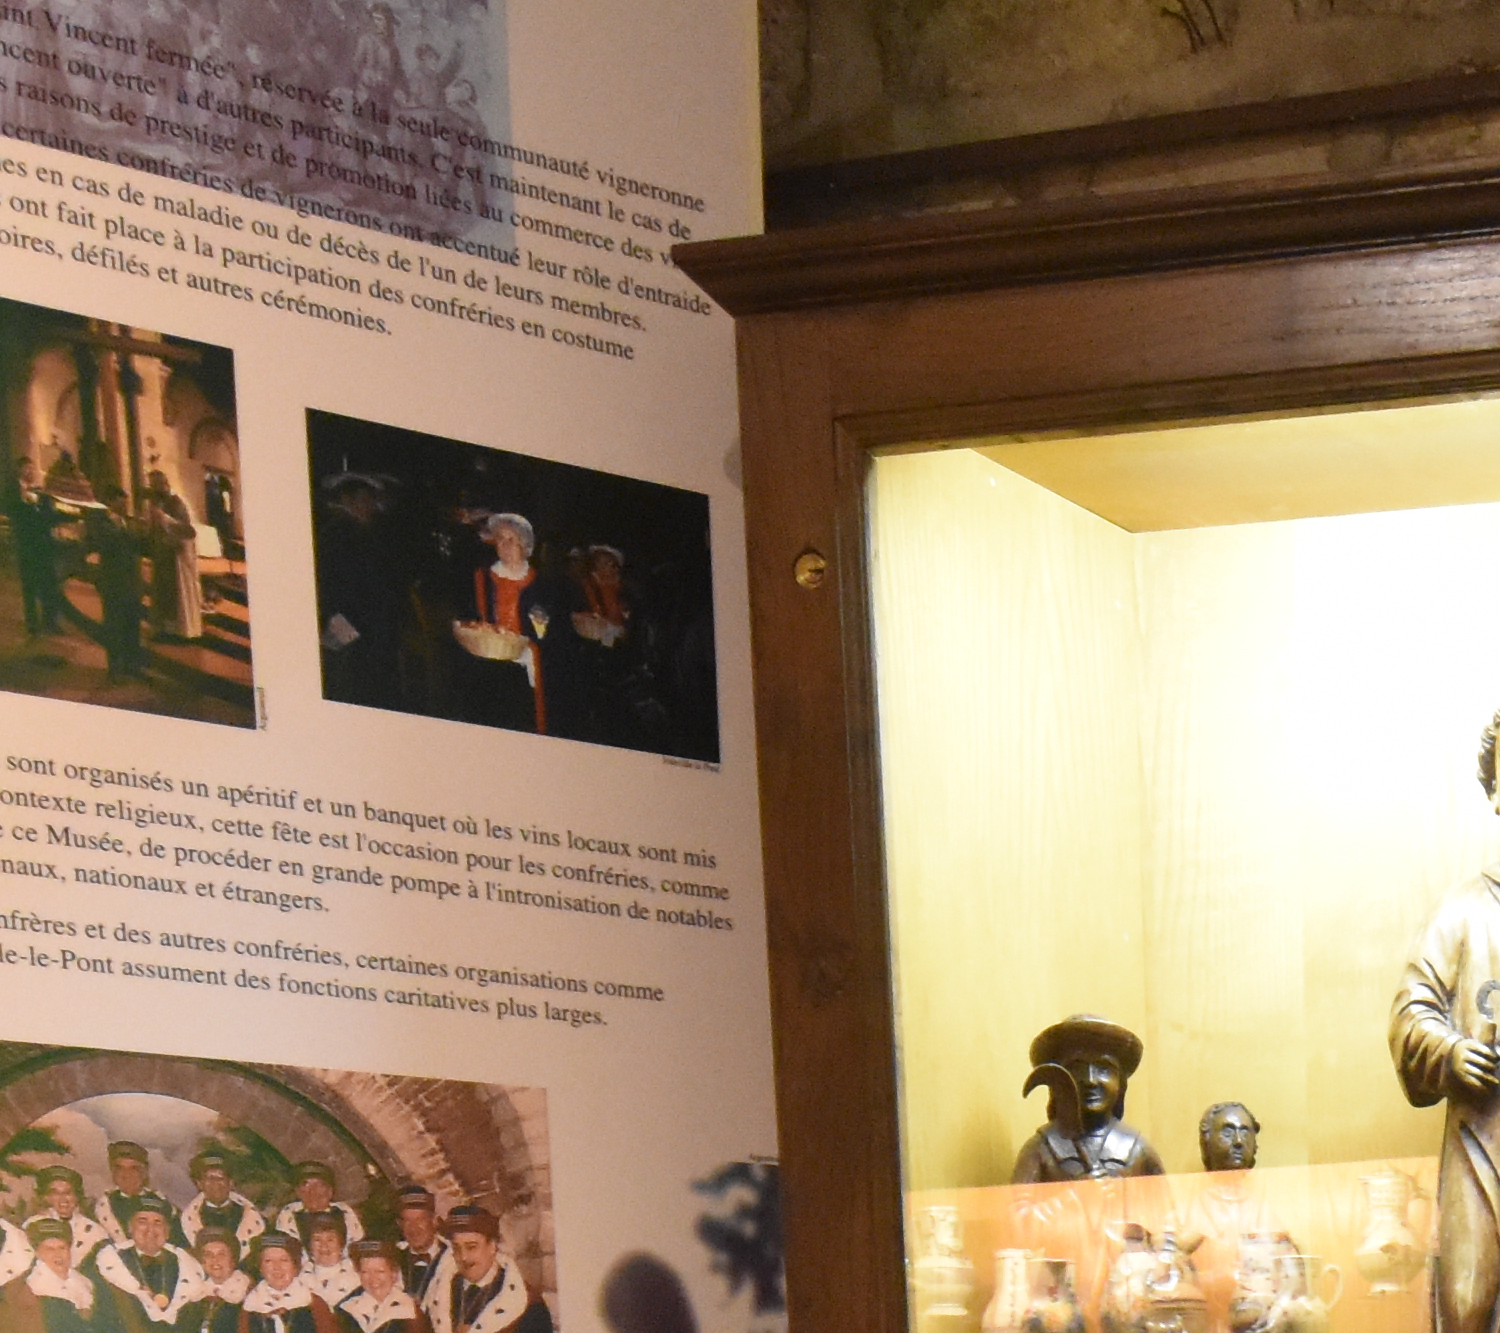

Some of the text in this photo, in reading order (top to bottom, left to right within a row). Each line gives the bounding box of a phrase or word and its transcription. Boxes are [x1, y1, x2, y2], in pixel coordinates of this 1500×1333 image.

[6, 755, 56, 777] sont
[62, 763, 174, 792] organisés
[180, 779, 209, 798] un
[216, 784, 298, 810] apéritif
[302, 797, 323, 814] et
[329, 800, 357, 819] un
[362, 800, 446, 833] banquet
[451, 814, 478, 836] où
[484, 817, 513, 840] les
[518, 824, 561, 847] vins
[566, 828, 632, 858] locaux
[637, 845, 678, 864] sont
[682, 848, 717, 869] mis
